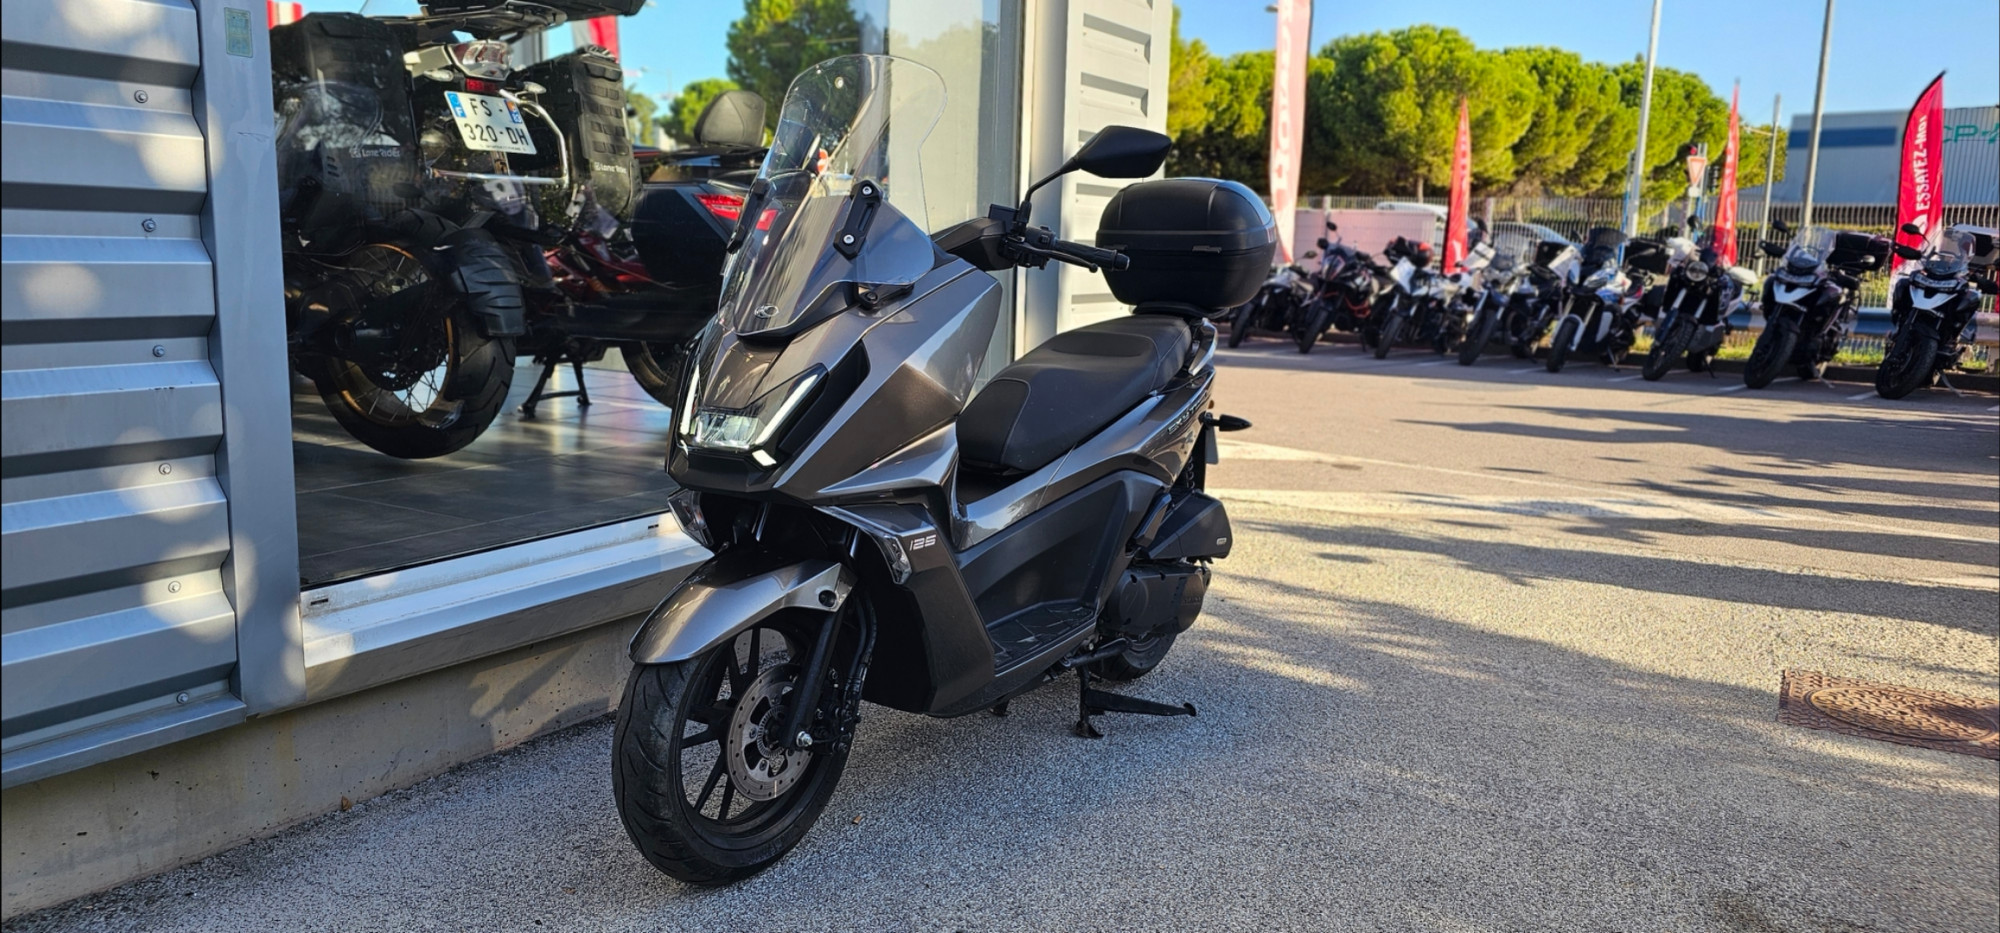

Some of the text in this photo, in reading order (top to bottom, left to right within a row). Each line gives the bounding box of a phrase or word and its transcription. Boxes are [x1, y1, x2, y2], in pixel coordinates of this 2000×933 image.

[464, 123, 529, 146] 320-DH
[1913, 115, 1931, 211] ESSAYEZ-MOI
[909, 534, 937, 552] 125
